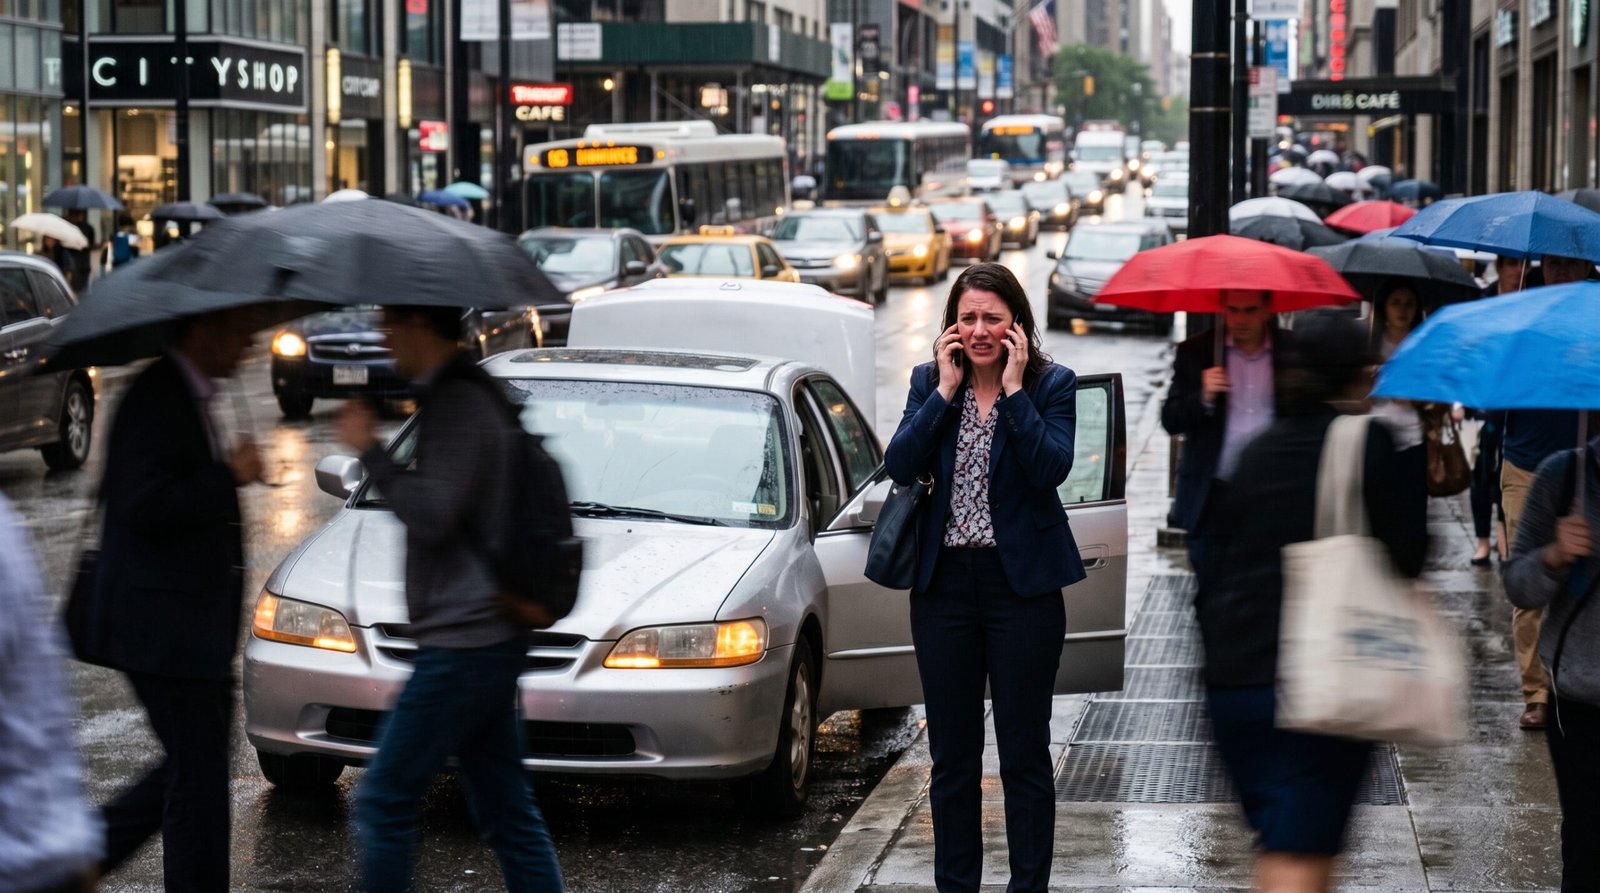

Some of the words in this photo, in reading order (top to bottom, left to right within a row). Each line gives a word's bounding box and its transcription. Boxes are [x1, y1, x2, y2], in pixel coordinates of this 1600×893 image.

[92, 57, 298, 93] CIYSHOP
[1356, 90, 1400, 109] CAFÉ
[515, 105, 565, 121] CAFE
